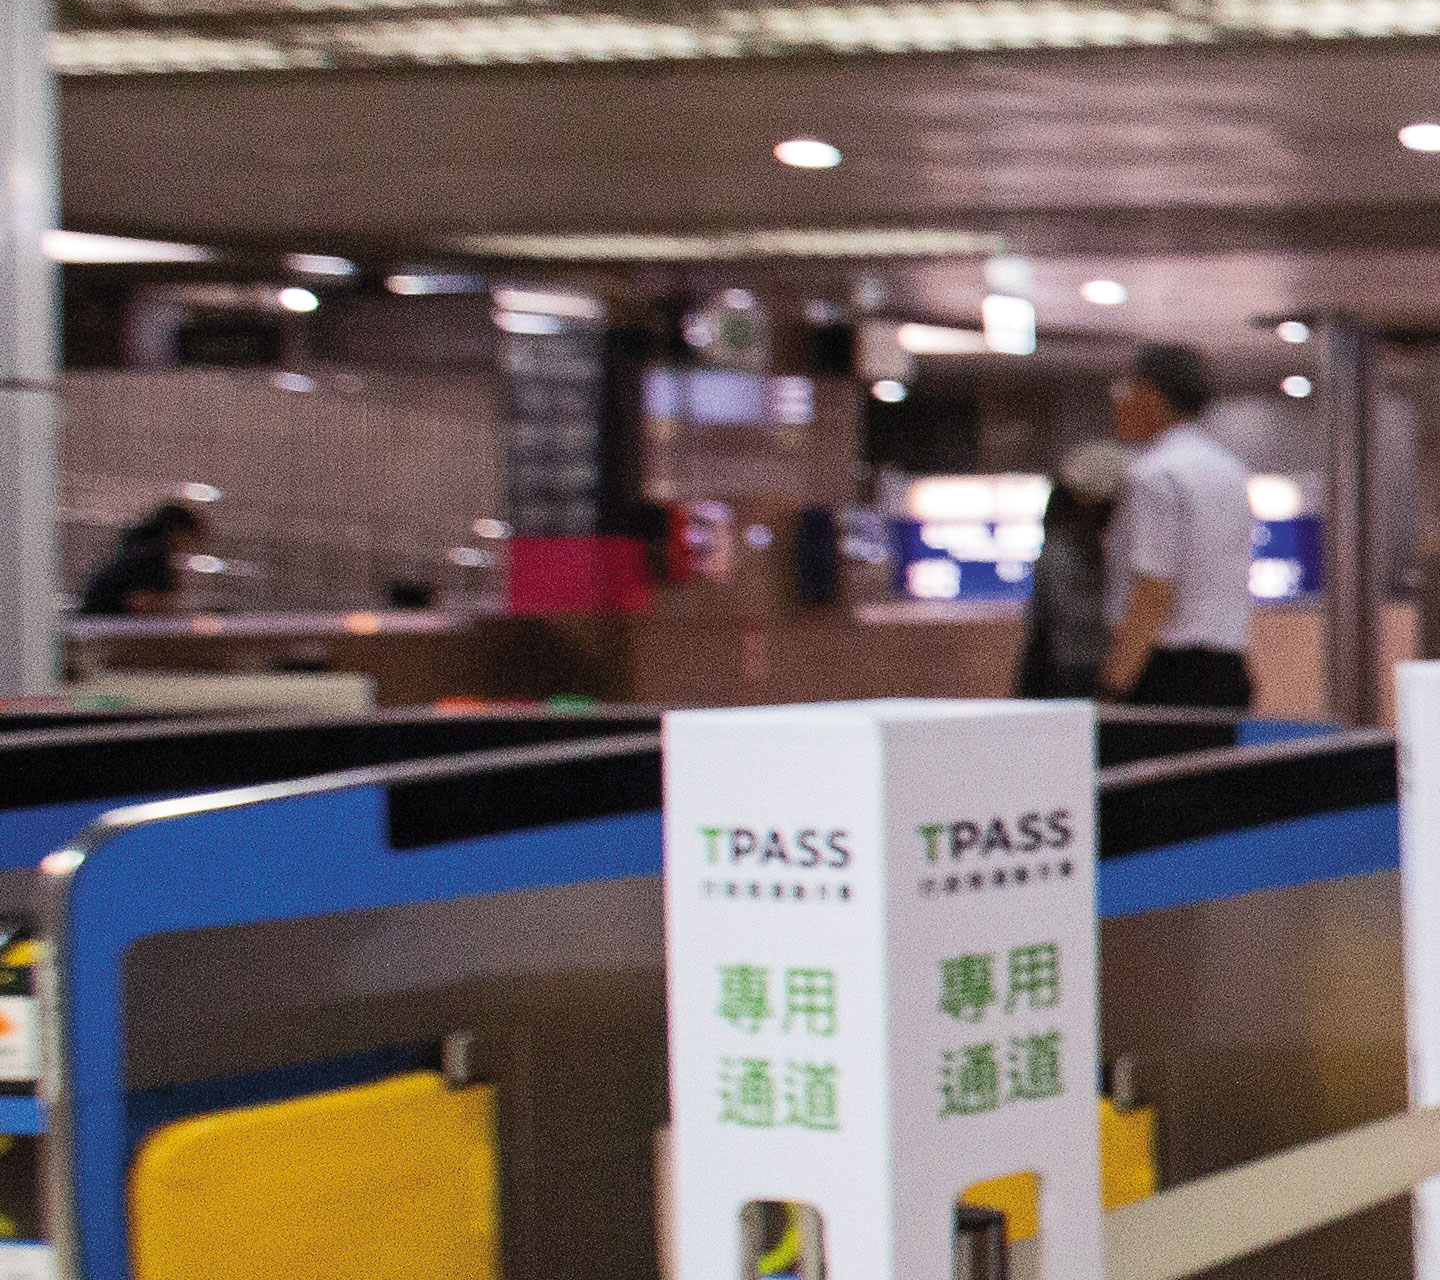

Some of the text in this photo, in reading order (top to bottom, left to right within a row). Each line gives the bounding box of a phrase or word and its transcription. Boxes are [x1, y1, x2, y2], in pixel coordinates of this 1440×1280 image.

[700, 823, 852, 869] TPASS
[919, 811, 1073, 862] TPASS
[717, 963, 836, 1034] 專用
[938, 942, 1062, 1022] 專用
[717, 1055, 842, 1132] 通道
[940, 1031, 1063, 1118] 通道
